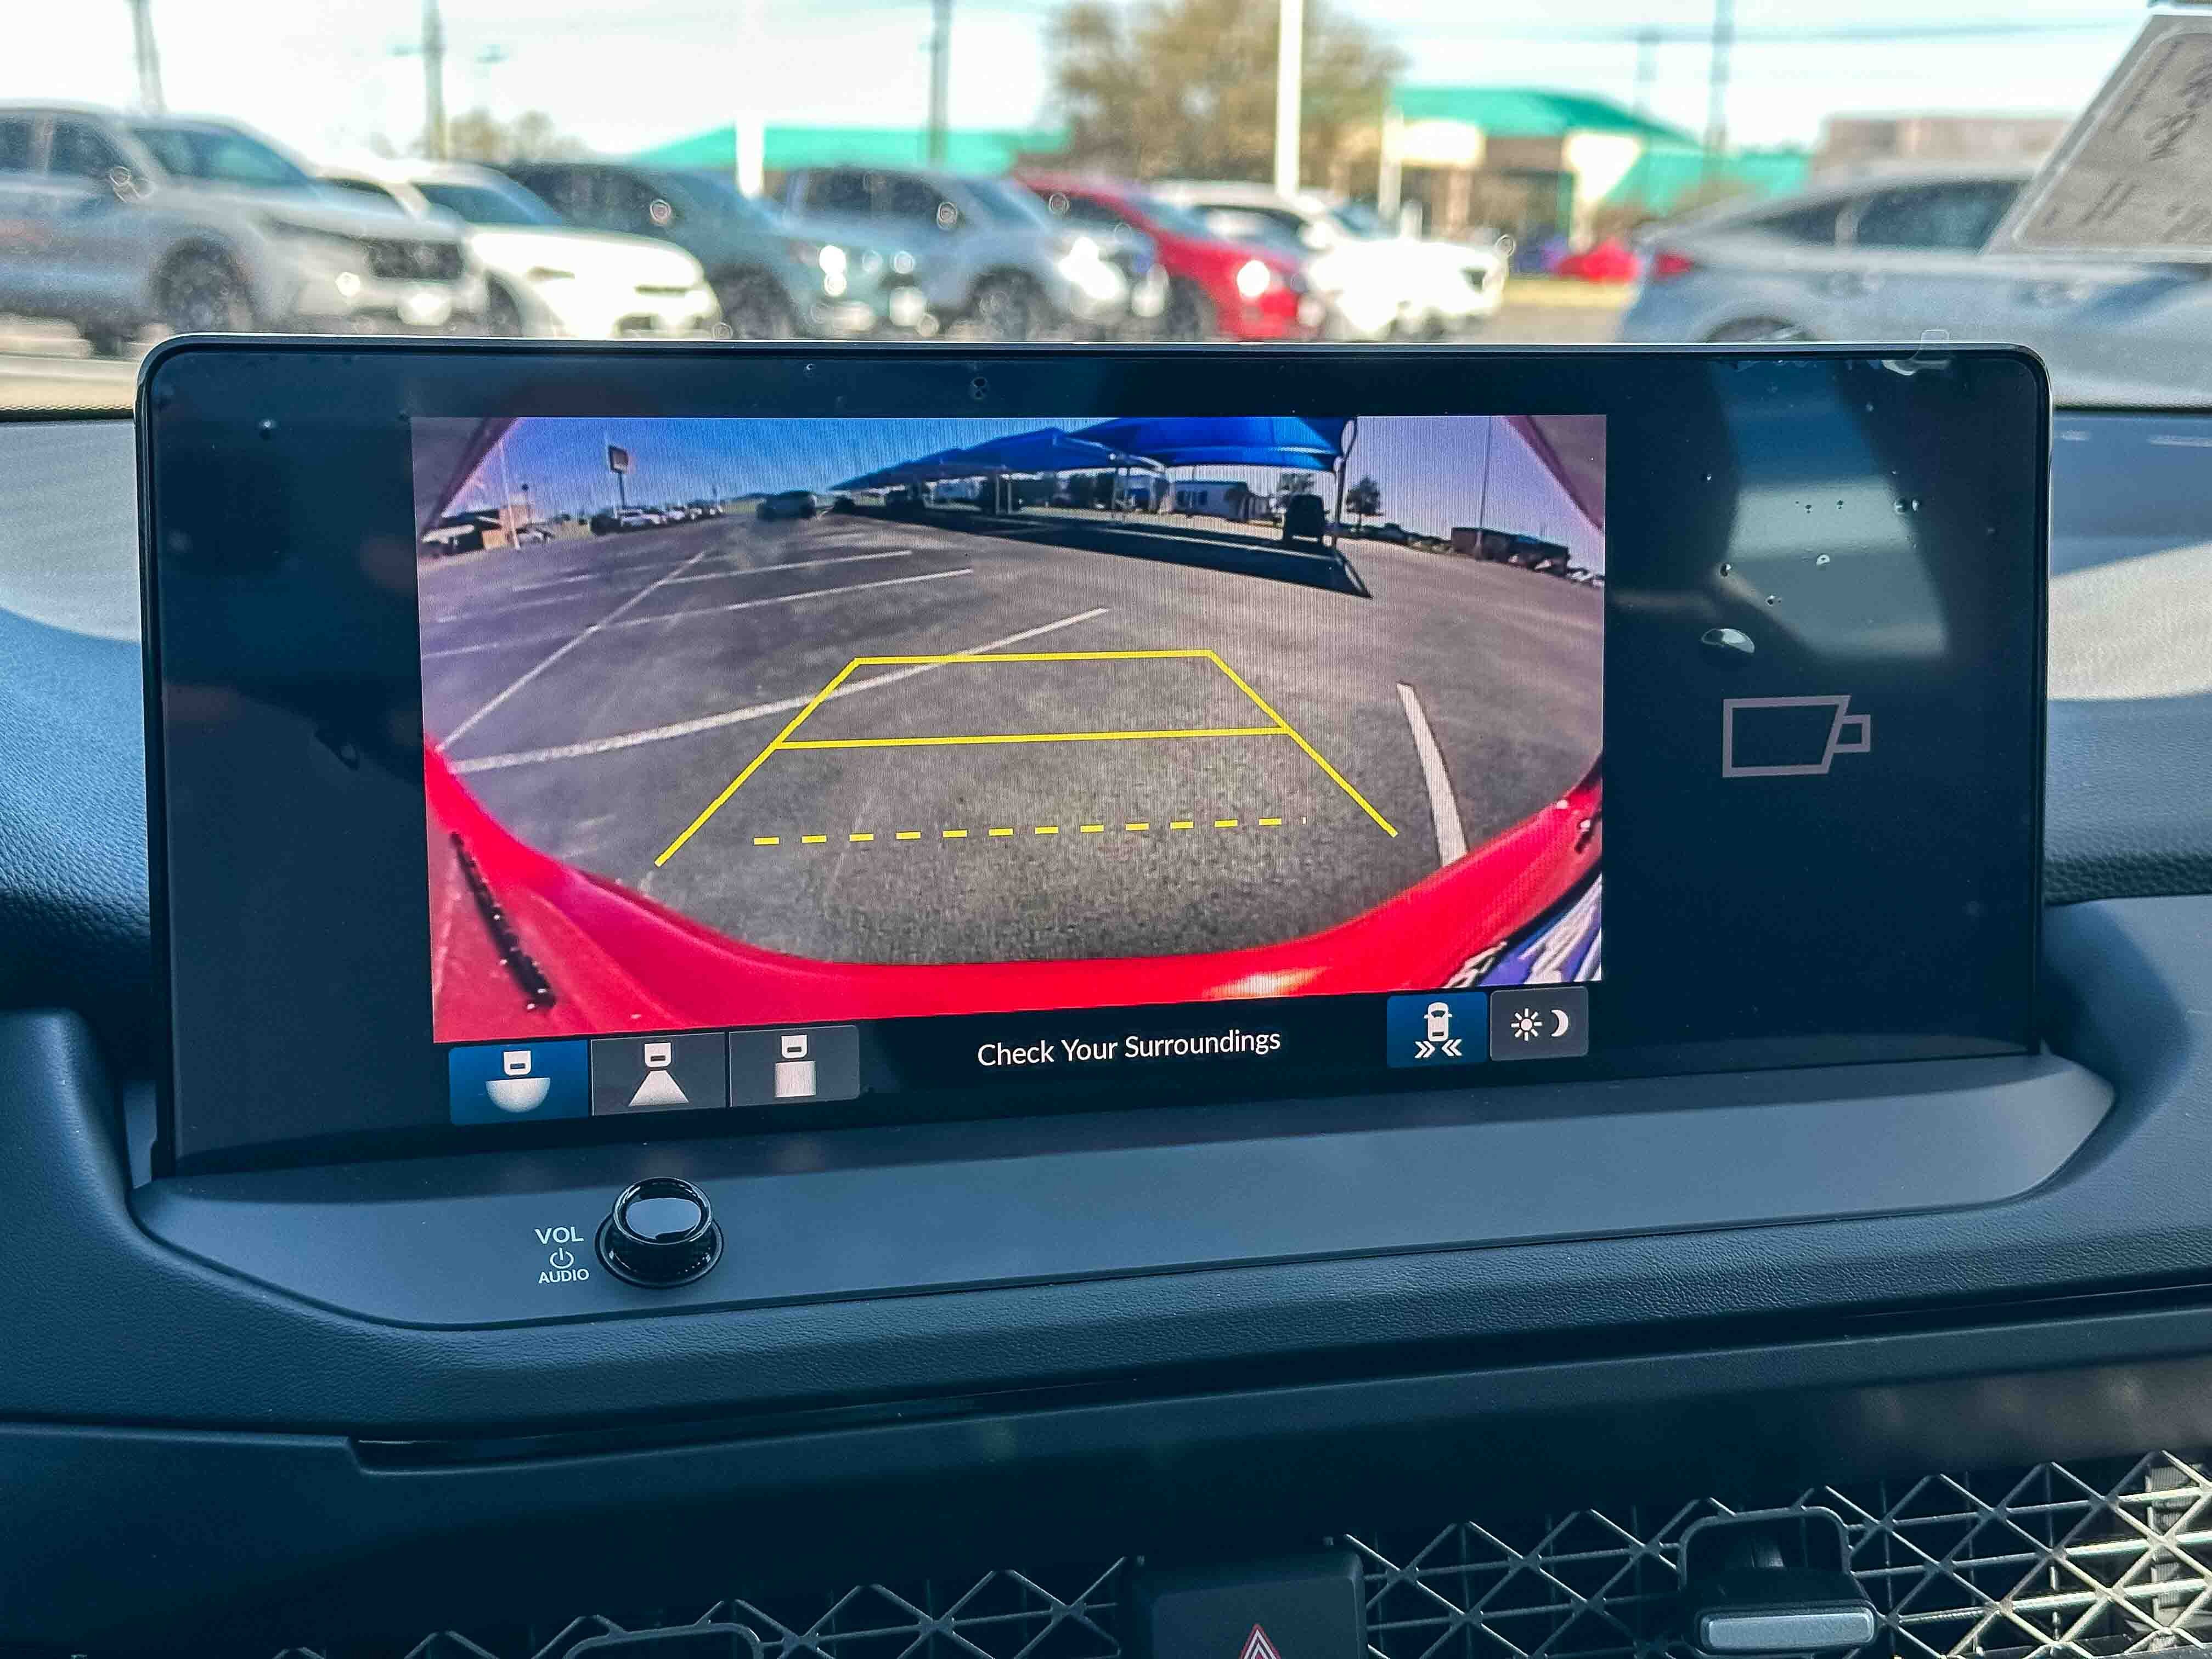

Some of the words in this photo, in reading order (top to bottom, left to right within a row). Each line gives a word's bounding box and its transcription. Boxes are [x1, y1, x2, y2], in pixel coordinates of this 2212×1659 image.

[977, 1040, 1055, 1066] Check
[1060, 1038, 1119, 1062] Your
[1124, 1029, 1281, 1058] Surroundings
[534, 1226, 584, 1244] VOL
[538, 1268, 590, 1284] AUDIO
